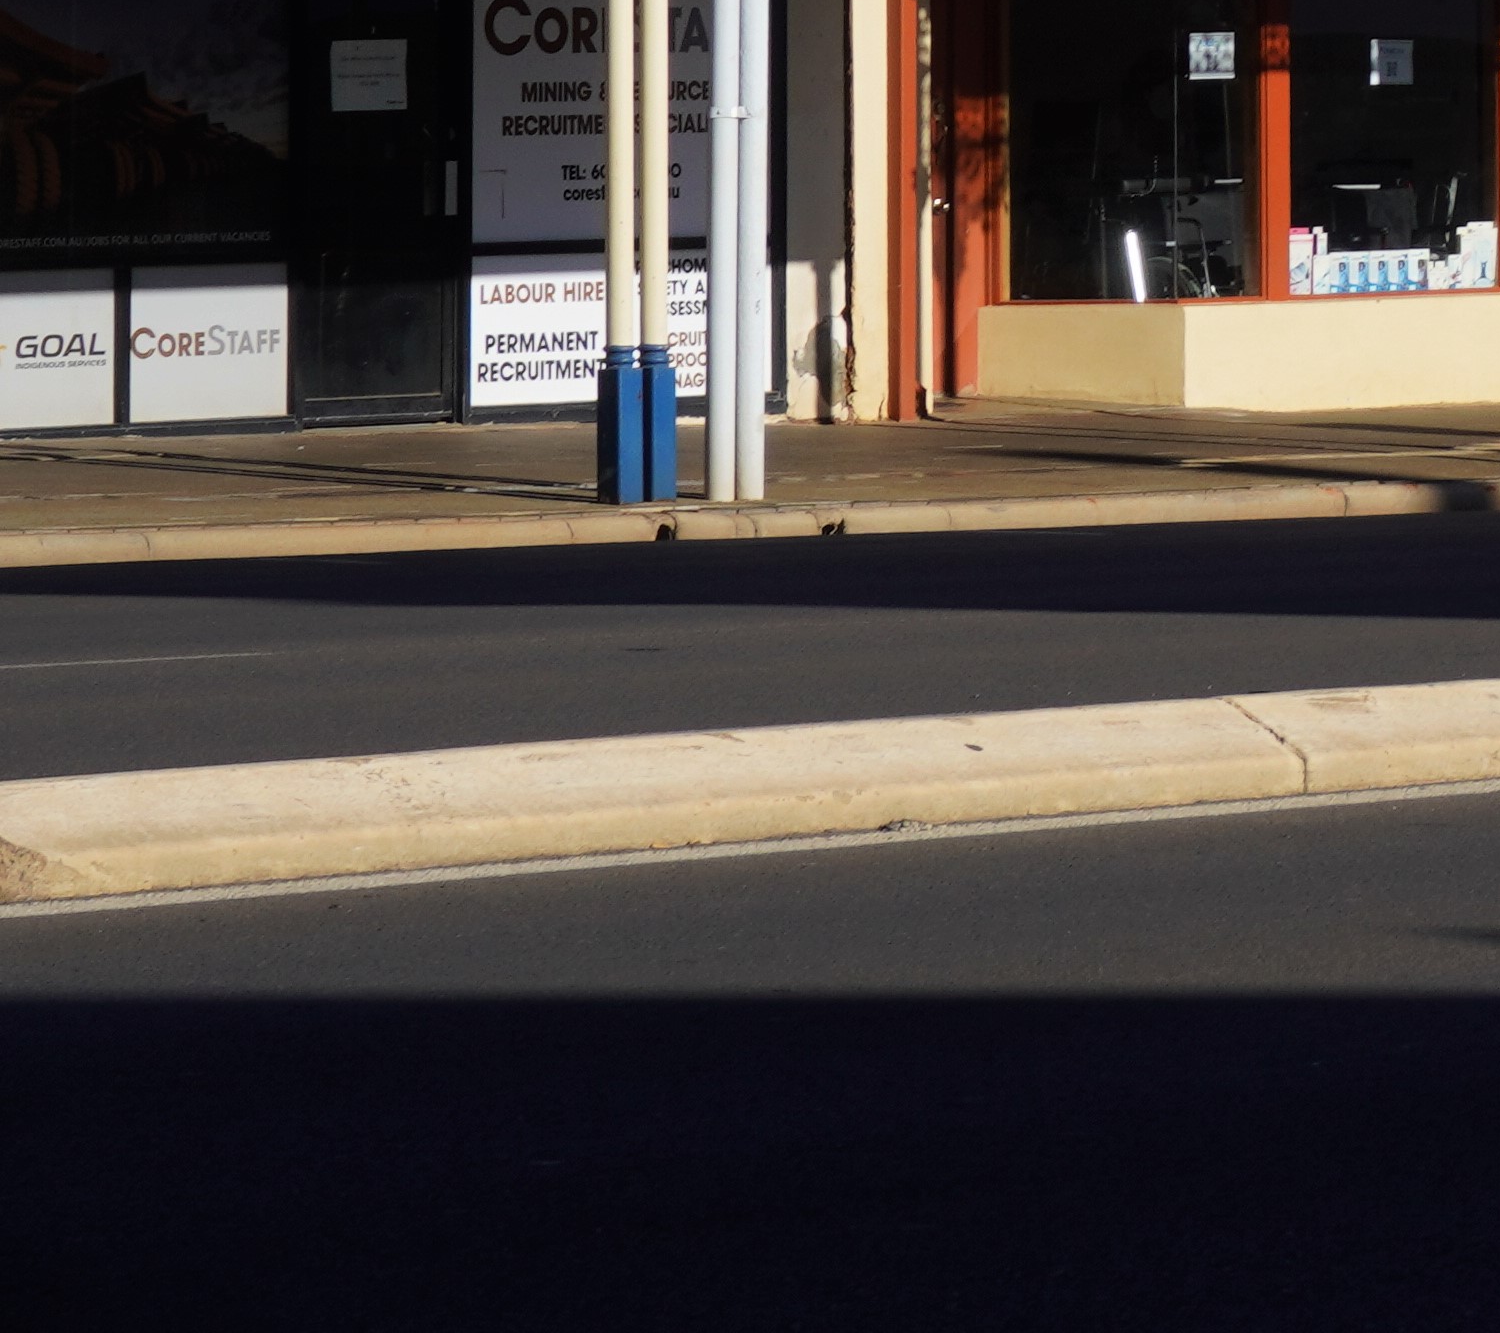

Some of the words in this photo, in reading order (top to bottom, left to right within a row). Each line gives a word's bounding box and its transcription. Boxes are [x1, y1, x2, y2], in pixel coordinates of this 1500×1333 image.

[521, 81, 592, 103] MINING
[502, 115, 606, 136] RECRUITME
[561, 164, 587, 181] TEL:
[133, 235, 149, 246] ALL
[152, 234, 172, 245] OUR
[174, 233, 217, 244] CURRENT
[221, 231, 272, 243] VACANCIES
[480, 282, 556, 305] LABOUR
[563, 281, 605, 303] HIRE
[15, 332, 106, 358] GOAL
[485, 331, 598, 355] PERMANENT
[67, 359, 106, 369] SERVICES
